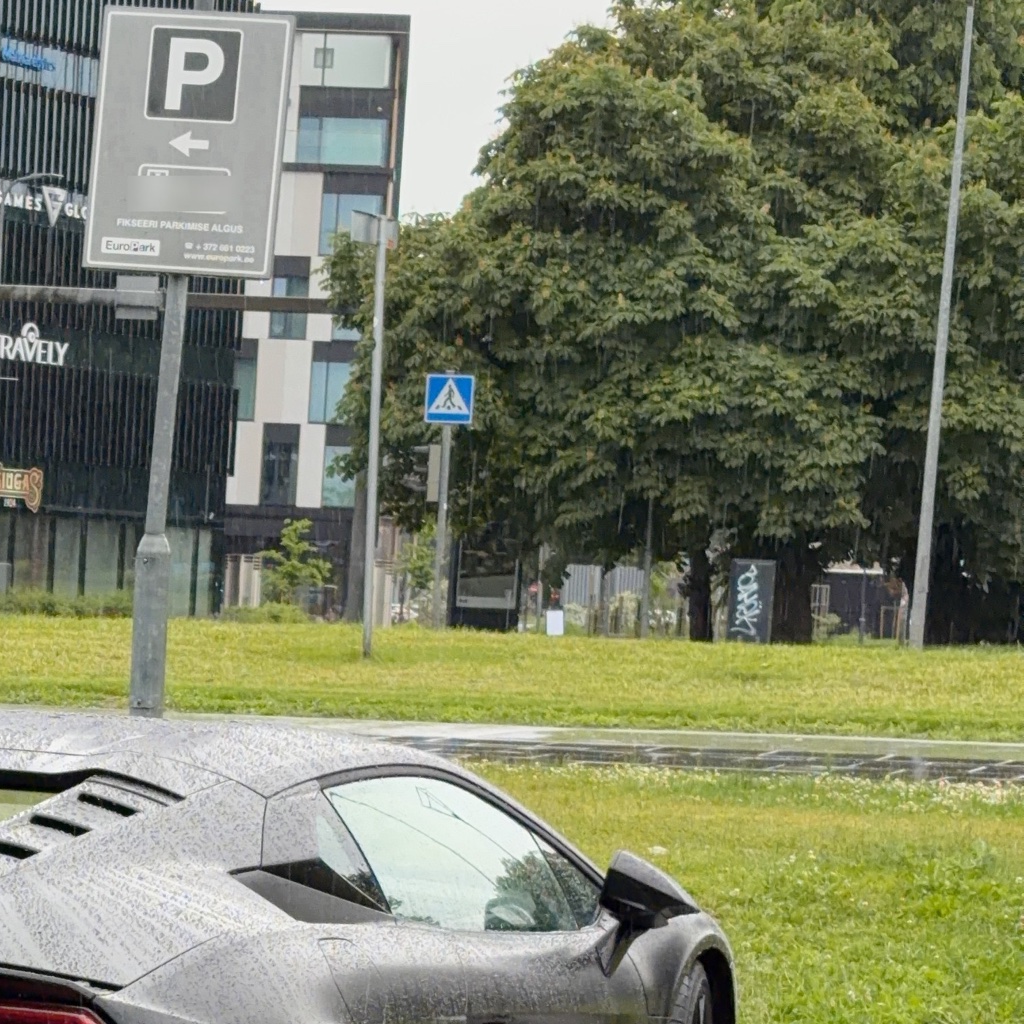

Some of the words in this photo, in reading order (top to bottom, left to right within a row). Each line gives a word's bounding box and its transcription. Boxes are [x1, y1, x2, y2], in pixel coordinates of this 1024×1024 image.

[164, 37, 225, 111] P
[116, 218, 158, 229] FIKSEERI
[159, 220, 210, 232] PARKIMISE
[211, 223, 244, 234] ALGUS
